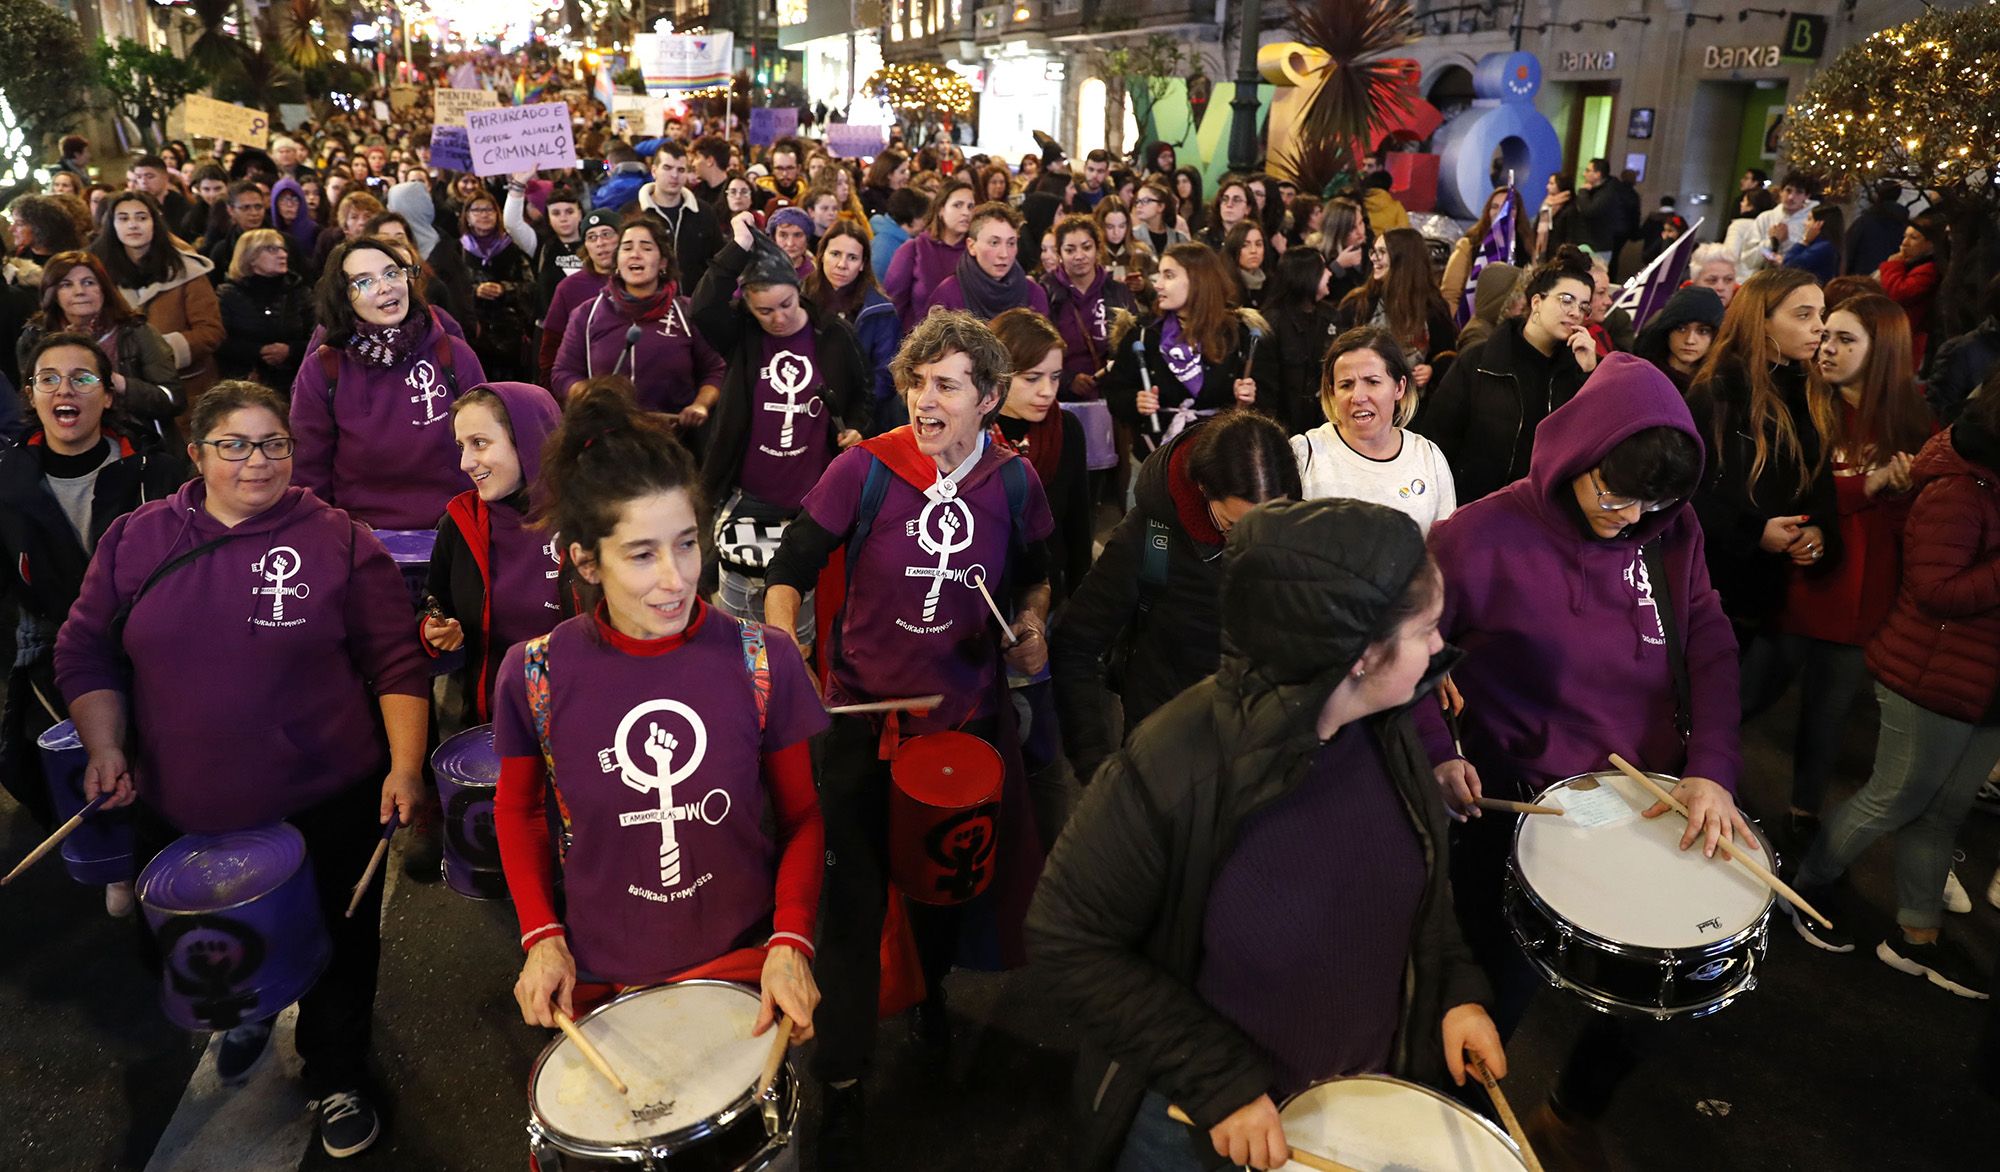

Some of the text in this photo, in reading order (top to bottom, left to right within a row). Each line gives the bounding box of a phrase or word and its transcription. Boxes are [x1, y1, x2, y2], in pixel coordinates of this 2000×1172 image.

[1704, 45, 1780, 68] Bankia
[470, 106, 563, 129] PATRIARCADO E
[522, 123, 564, 136] ALIANZA
[483, 143, 555, 165] CRIMINAL
